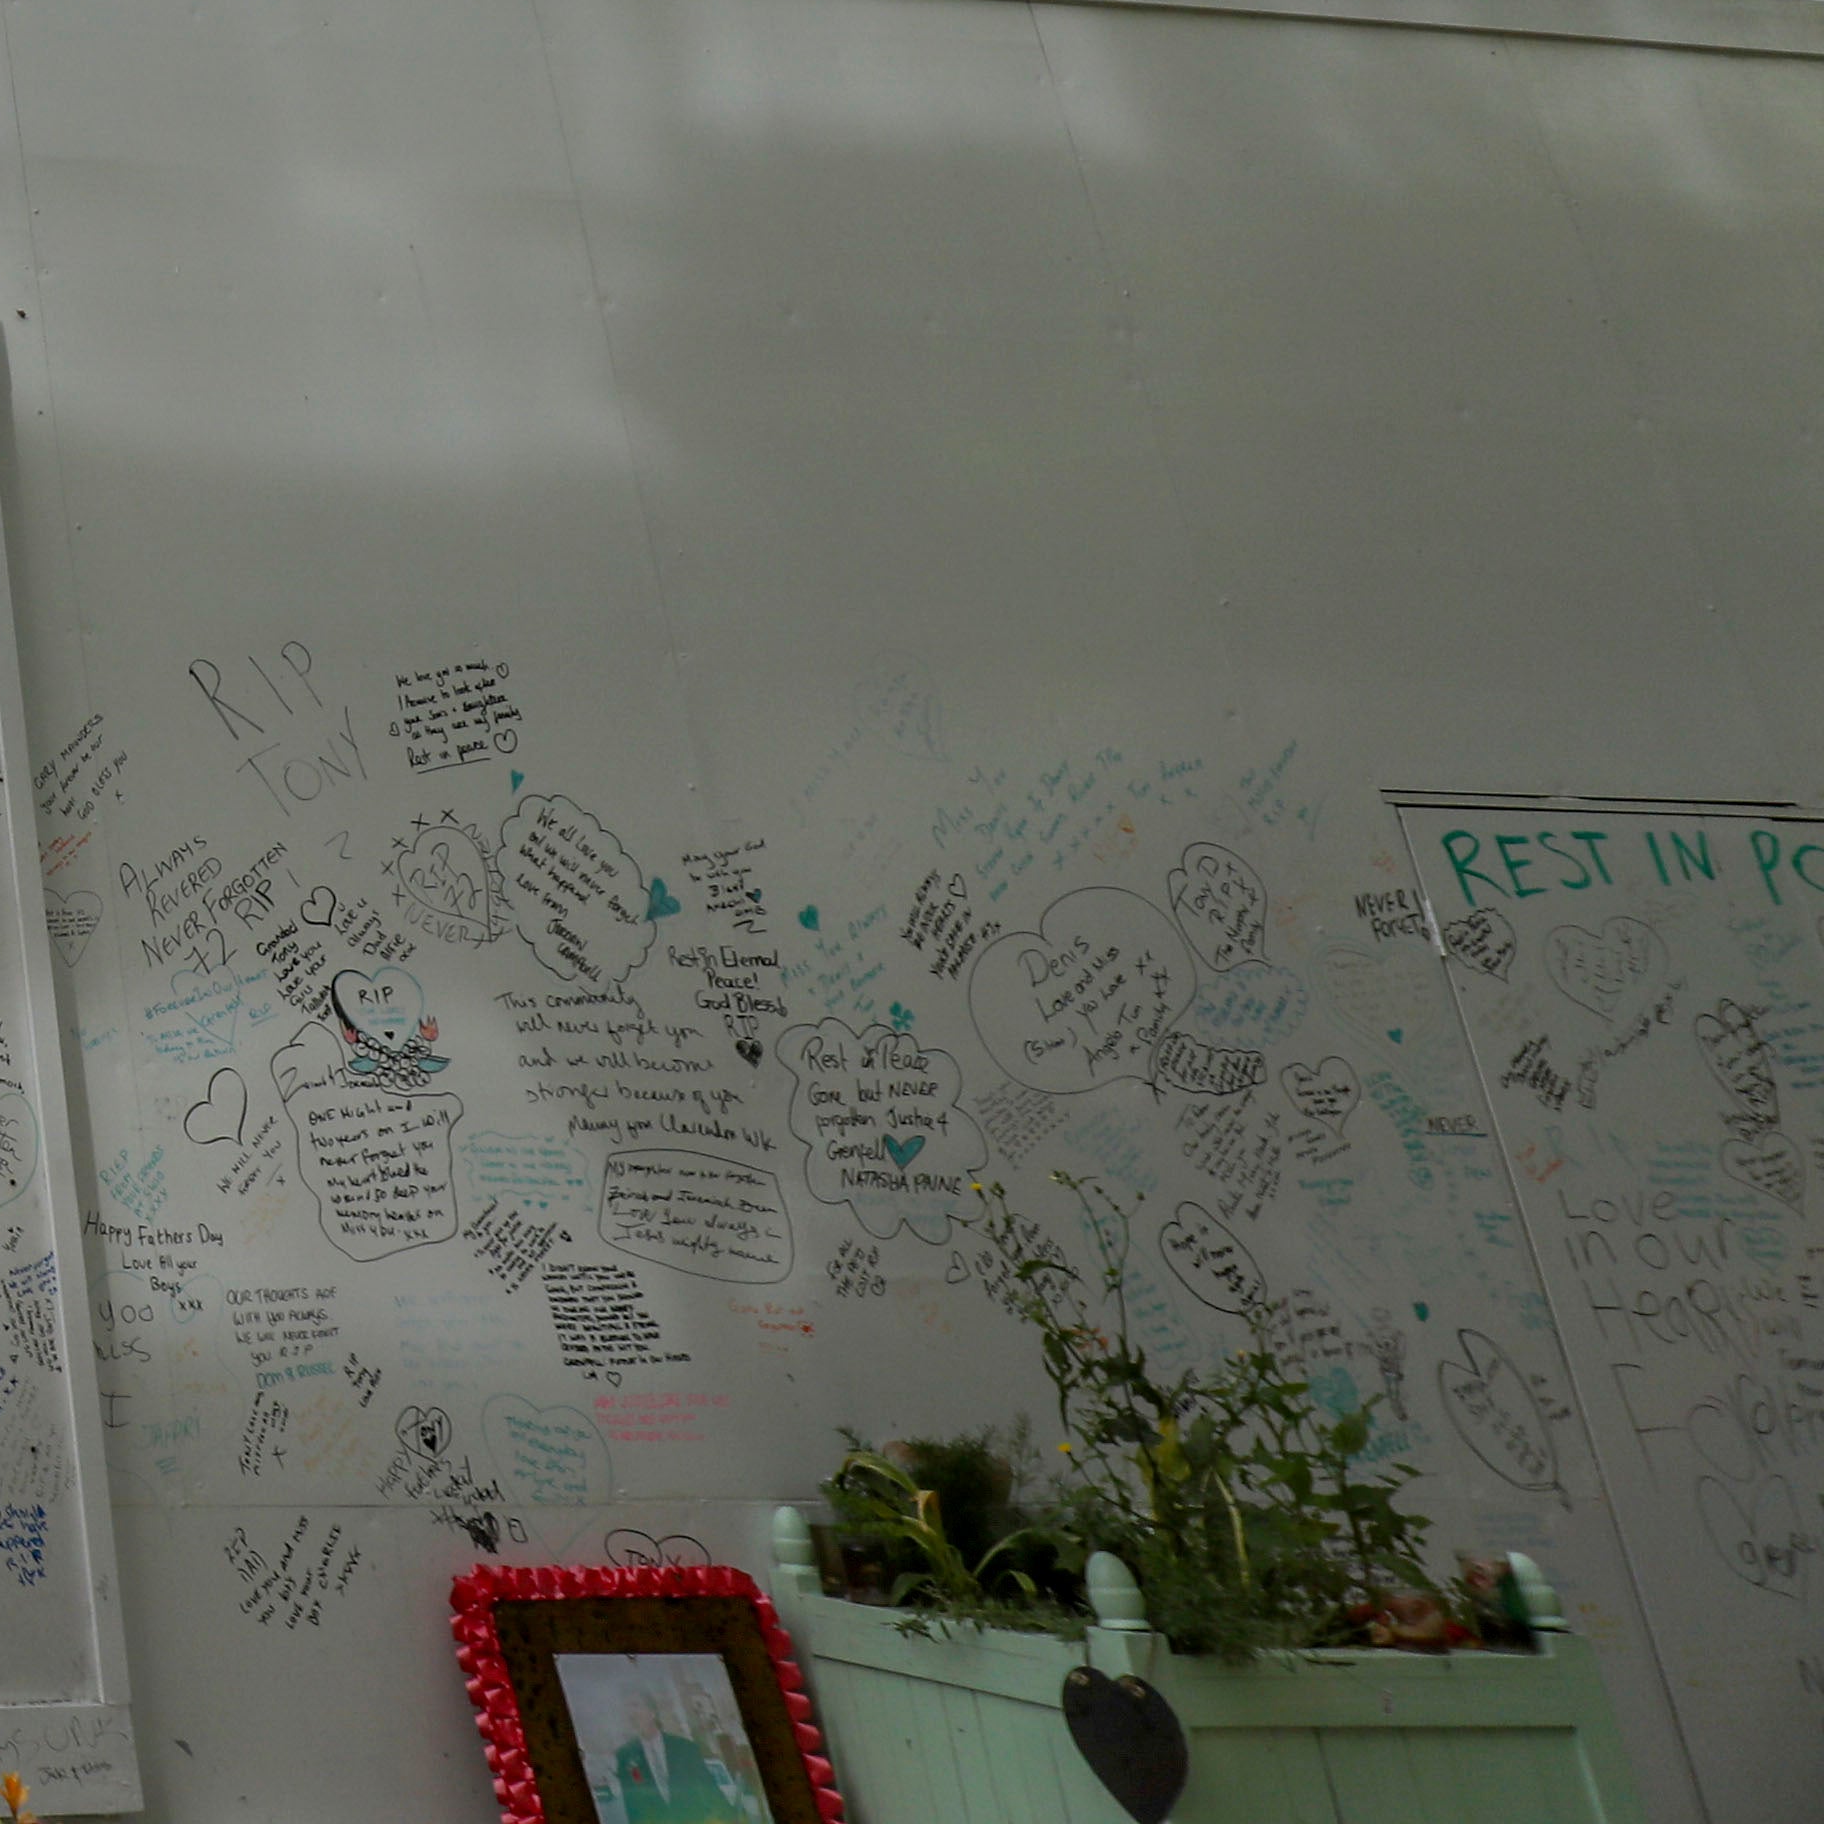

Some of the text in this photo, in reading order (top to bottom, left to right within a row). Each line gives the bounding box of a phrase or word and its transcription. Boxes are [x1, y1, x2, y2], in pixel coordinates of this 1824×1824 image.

[189, 641, 323, 741] RIP
[236, 705, 368, 817] TONY
[119, 836, 207, 899] ALWAYS
[1442, 830, 1613, 906] REST
[1646, 830, 1715, 886] IN
[141, 841, 288, 968] NEVER FORGOTTEN
[146, 857, 222, 927] REVERED
[1017, 936, 1090, 987] Denis
[494, 992, 537, 1009] This
[695, 989, 731, 1010] God
[801, 1036, 849, 1073] Rest
[876, 1034, 929, 1074] Peace
[808, 1079, 938, 1105] Gone but NEVER
[841, 1169, 908, 1191] NATASHA
[84, 1211, 223, 1246] Happy Fathers Day
[150, 1276, 181, 1298] Boys
